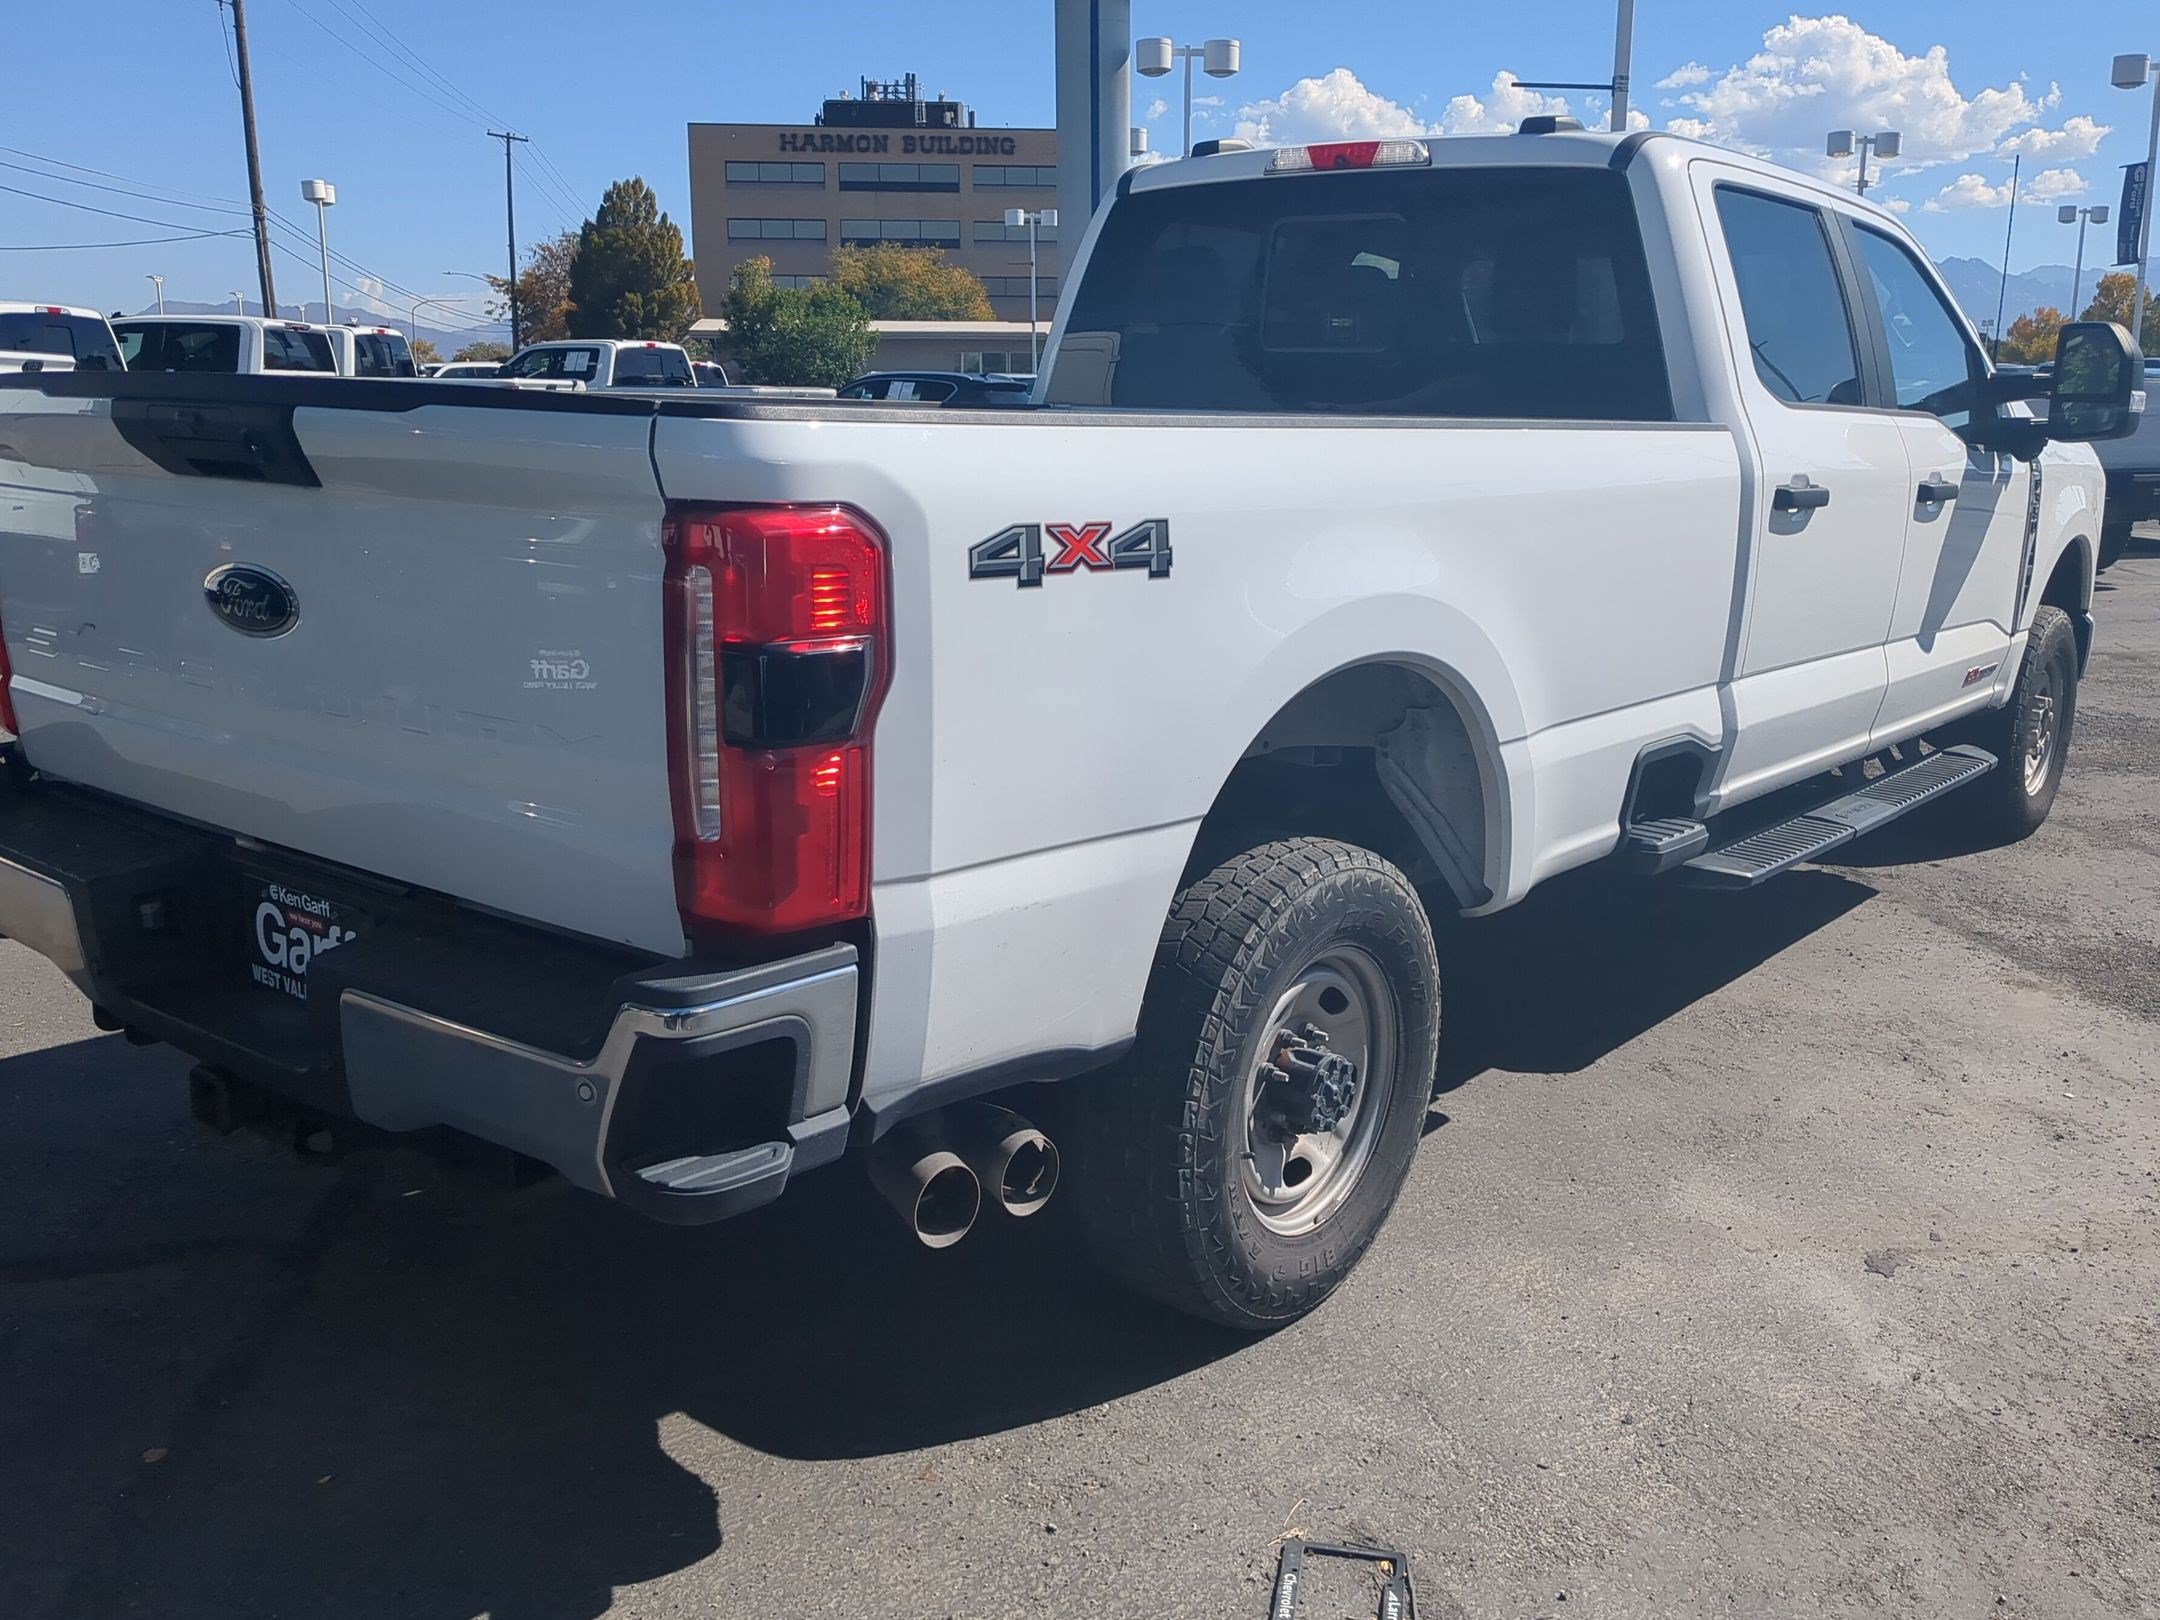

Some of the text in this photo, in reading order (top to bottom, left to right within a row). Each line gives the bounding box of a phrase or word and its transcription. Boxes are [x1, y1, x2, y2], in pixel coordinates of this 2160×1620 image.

[779, 132, 1016, 155] HARMON BUILDING
[220, 577, 271, 621] Ford
[251, 963, 307, 1000] WEST VAL
[1278, 1573, 1298, 1620] Chevrolet
